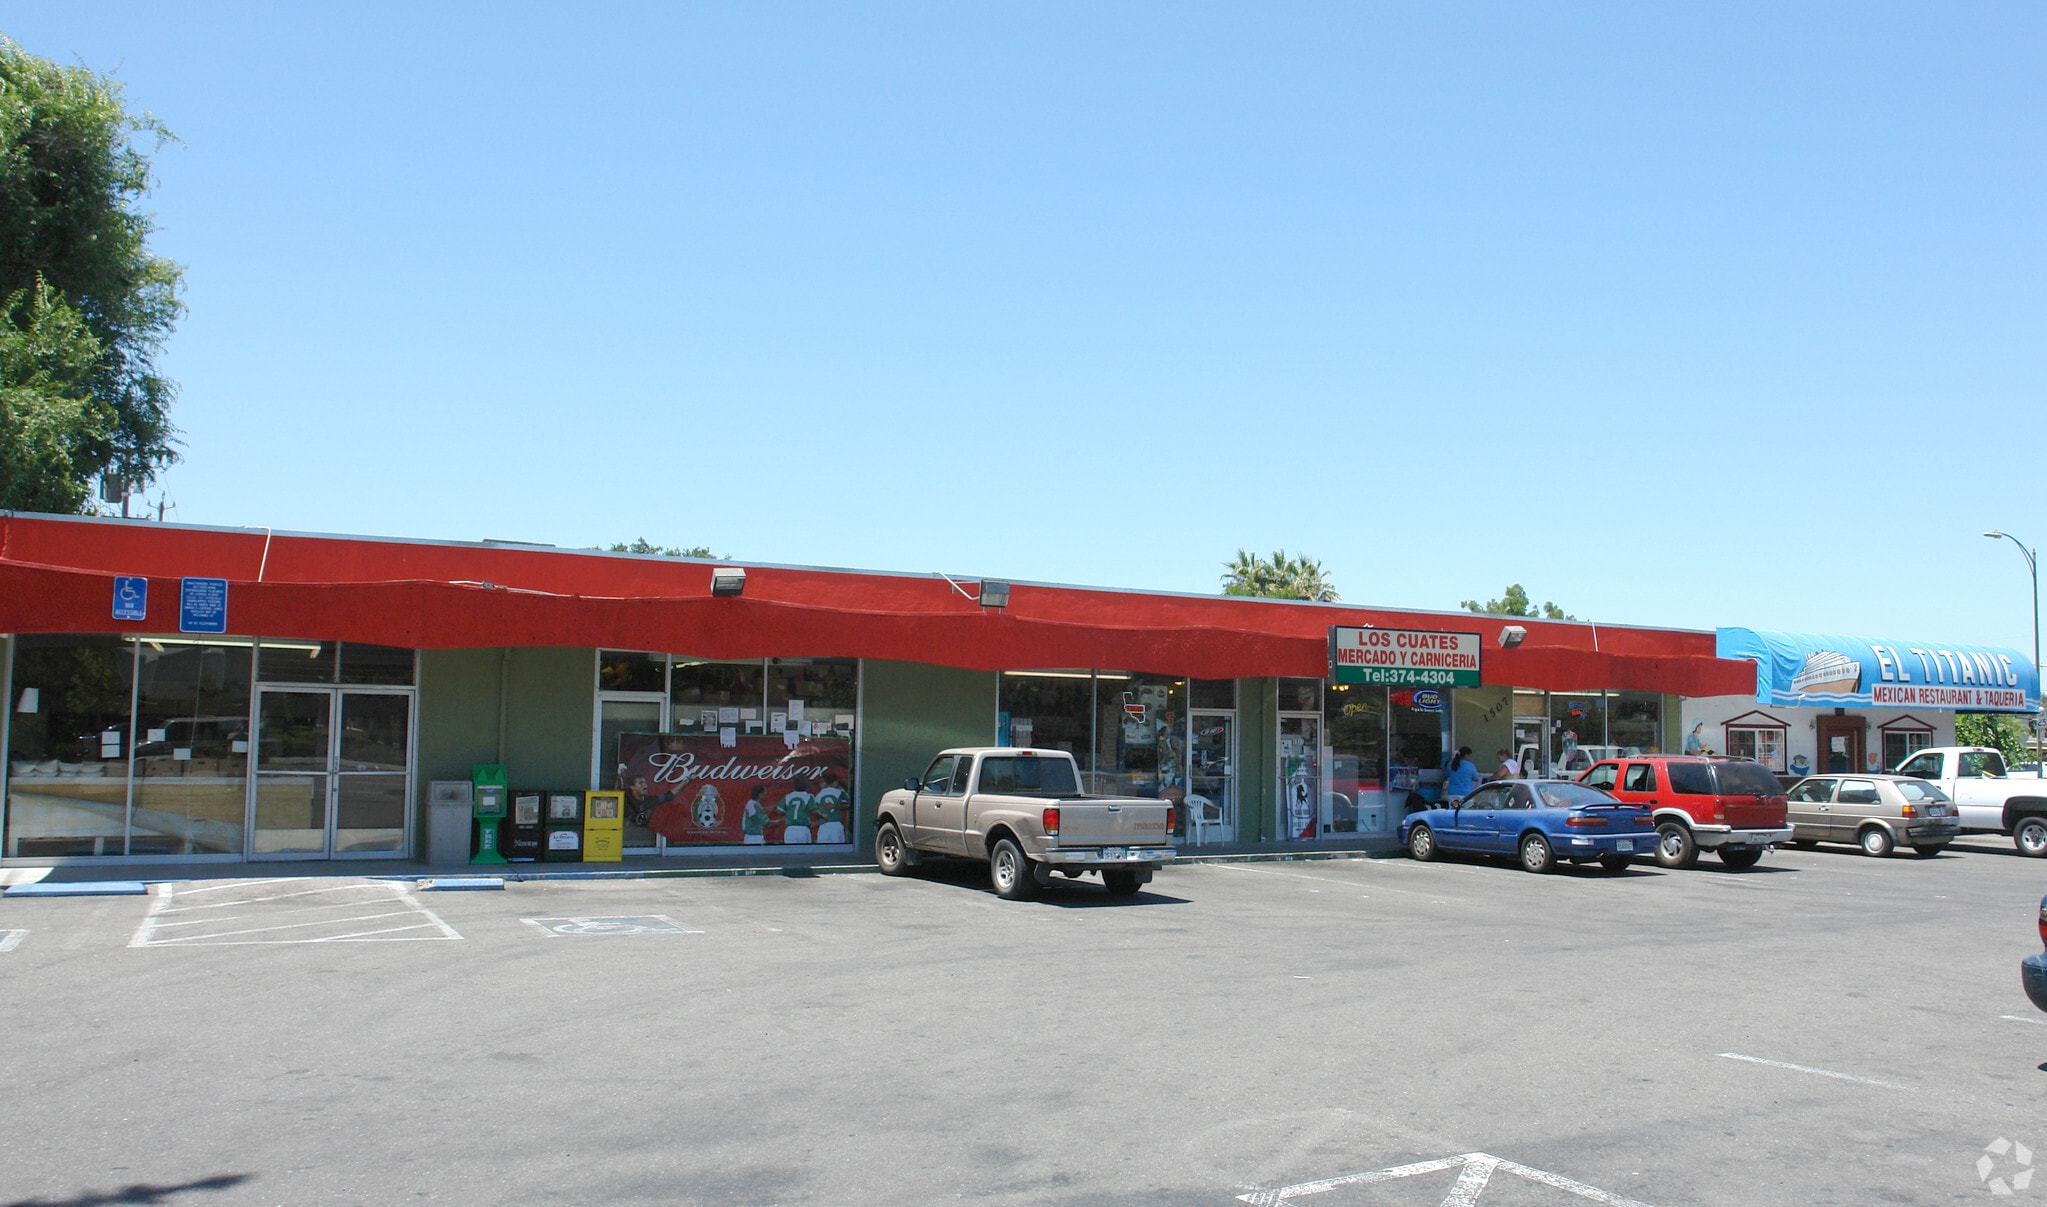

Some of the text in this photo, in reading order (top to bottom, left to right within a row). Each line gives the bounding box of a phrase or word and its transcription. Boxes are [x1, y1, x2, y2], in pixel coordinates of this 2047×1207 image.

[1358, 631, 1459, 650] LOS CUATES
[1338, 649, 1477, 669] MERCADO Y CARNICERIA
[1869, 644, 2018, 687] EL TITANIC
[1363, 668, 1455, 684] Tel:374-4304
[1873, 686, 2024, 707] MEXICAN RESTAURANT & TAQUERIA
[1343, 702, 1369, 718] Open
[1482, 696, 1510, 723] 1507
[790, 800, 800, 820] 7
